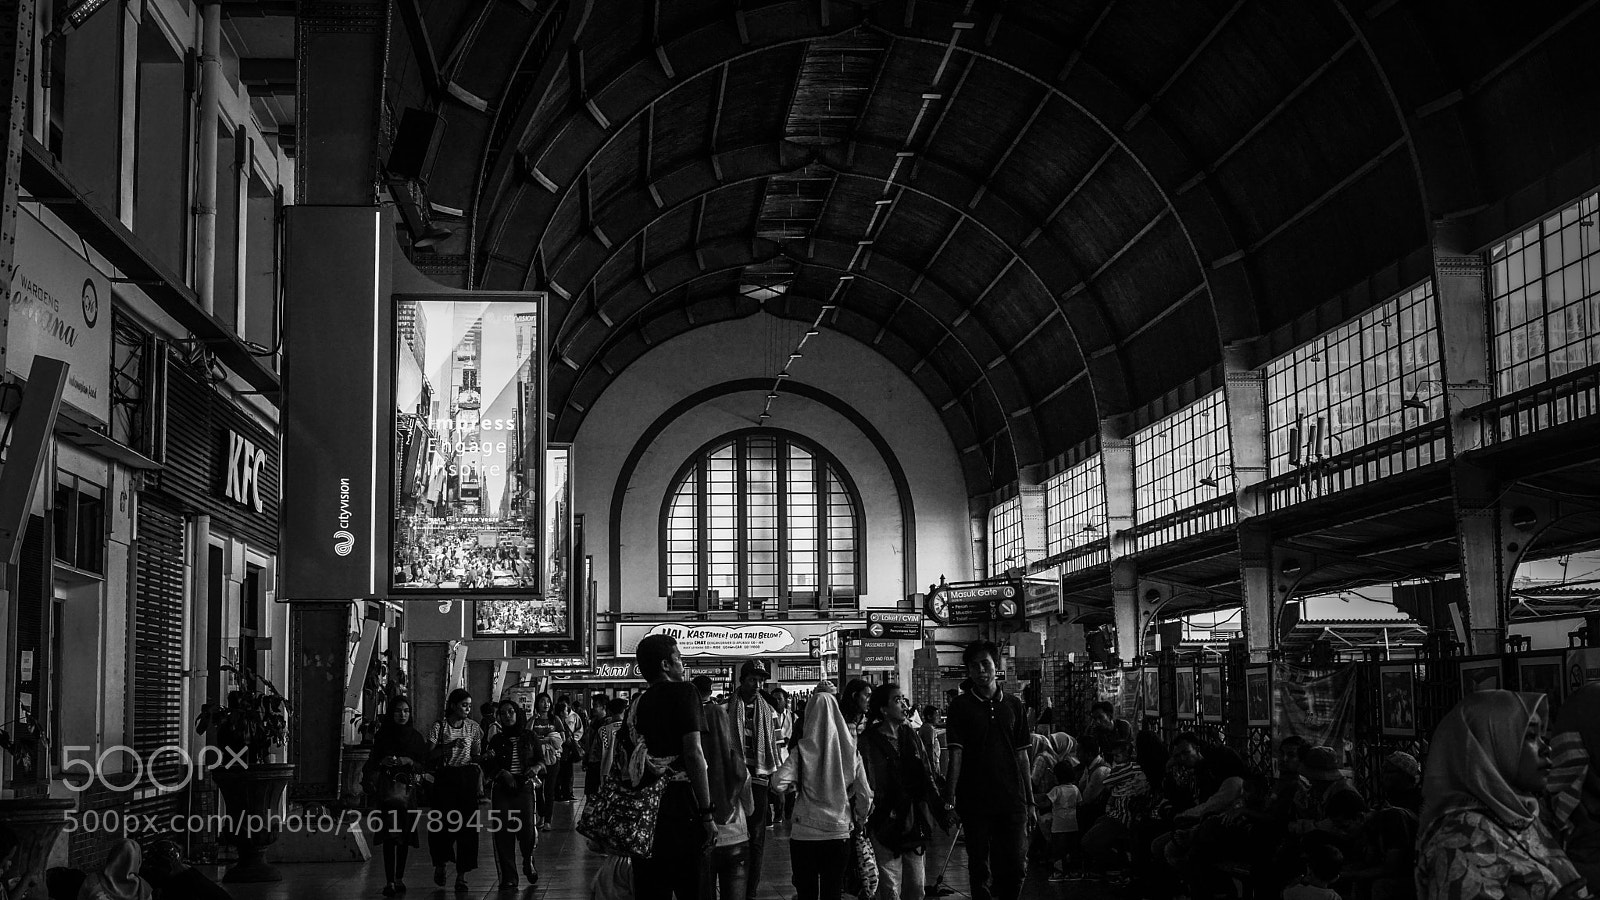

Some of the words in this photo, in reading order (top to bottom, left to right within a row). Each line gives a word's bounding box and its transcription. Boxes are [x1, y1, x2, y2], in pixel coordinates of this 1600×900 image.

[429, 417, 516, 434] Impress
[429, 437, 507, 456] Engage
[225, 429, 266, 514] KFC
[338, 478, 352, 529] cityvision
[950, 590, 977, 599] Masuk
[977, 588, 998, 597] Gate
